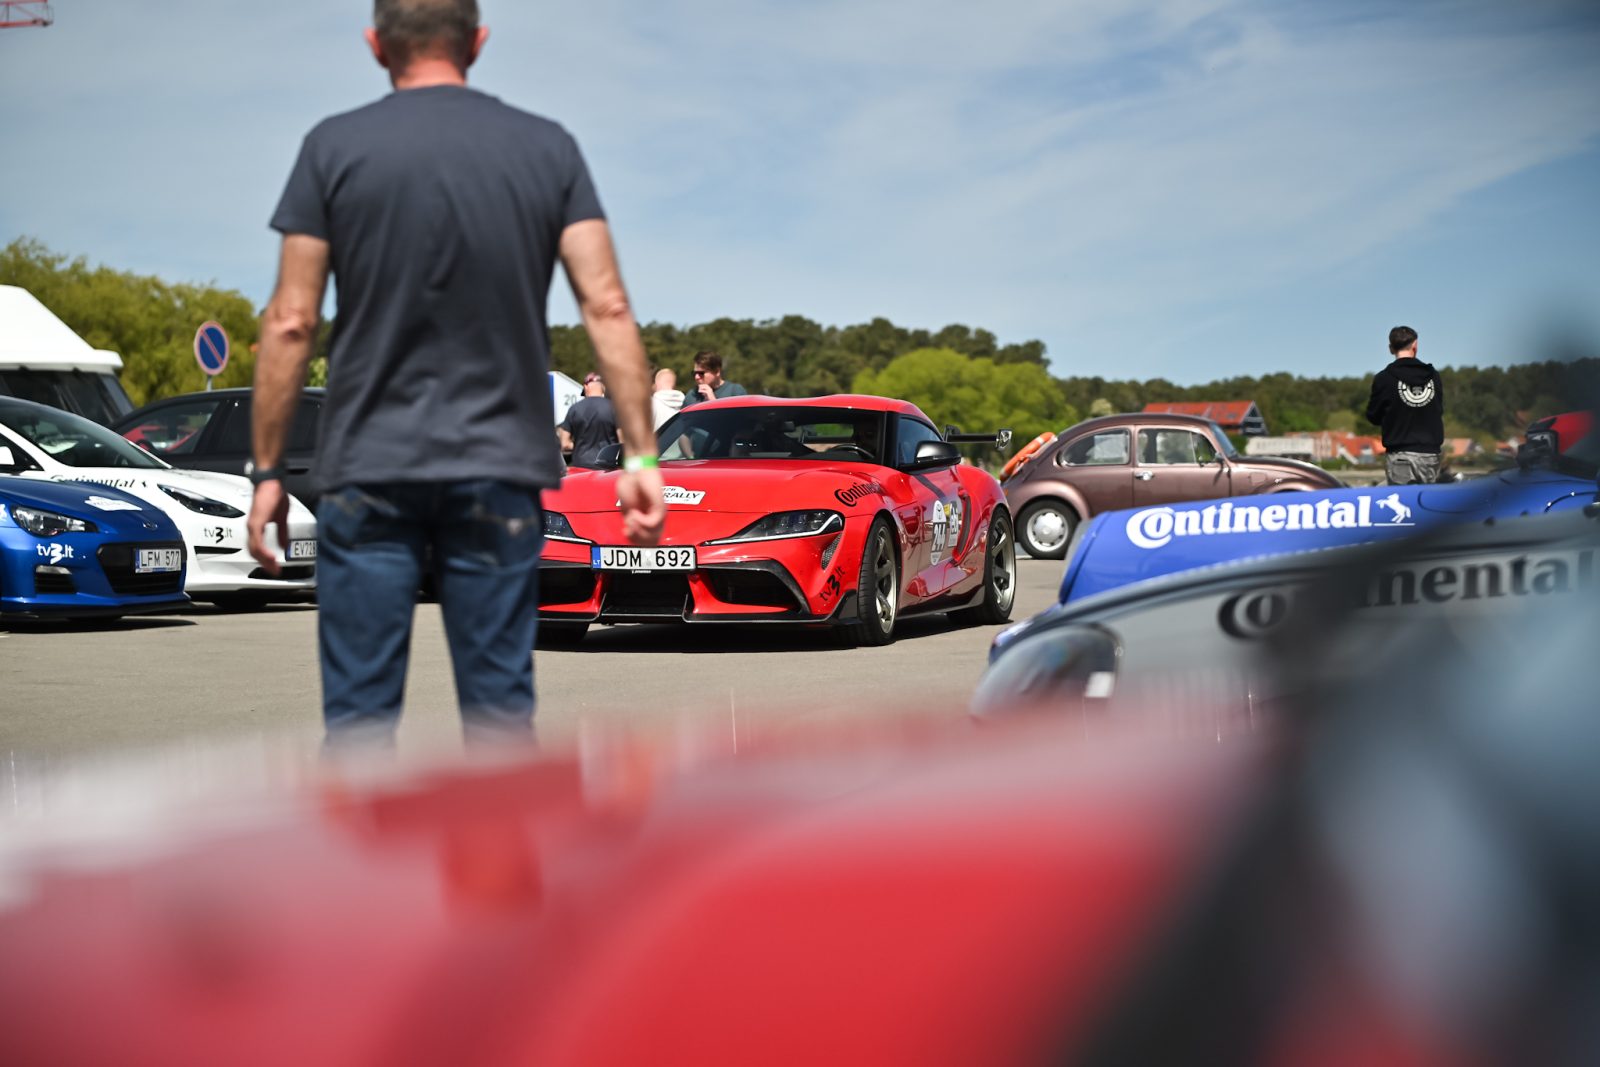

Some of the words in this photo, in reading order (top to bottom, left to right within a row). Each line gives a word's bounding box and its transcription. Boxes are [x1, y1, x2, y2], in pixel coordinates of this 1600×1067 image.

[1126, 496, 1372, 549] Continental
[204, 527, 232, 544] tv3.lt
[36, 543, 74, 565] tv3.lt
[141, 550, 161, 567] LFM
[165, 550, 180, 566] 577
[603, 550, 642, 567] JDM
[655, 550, 691, 567] 692
